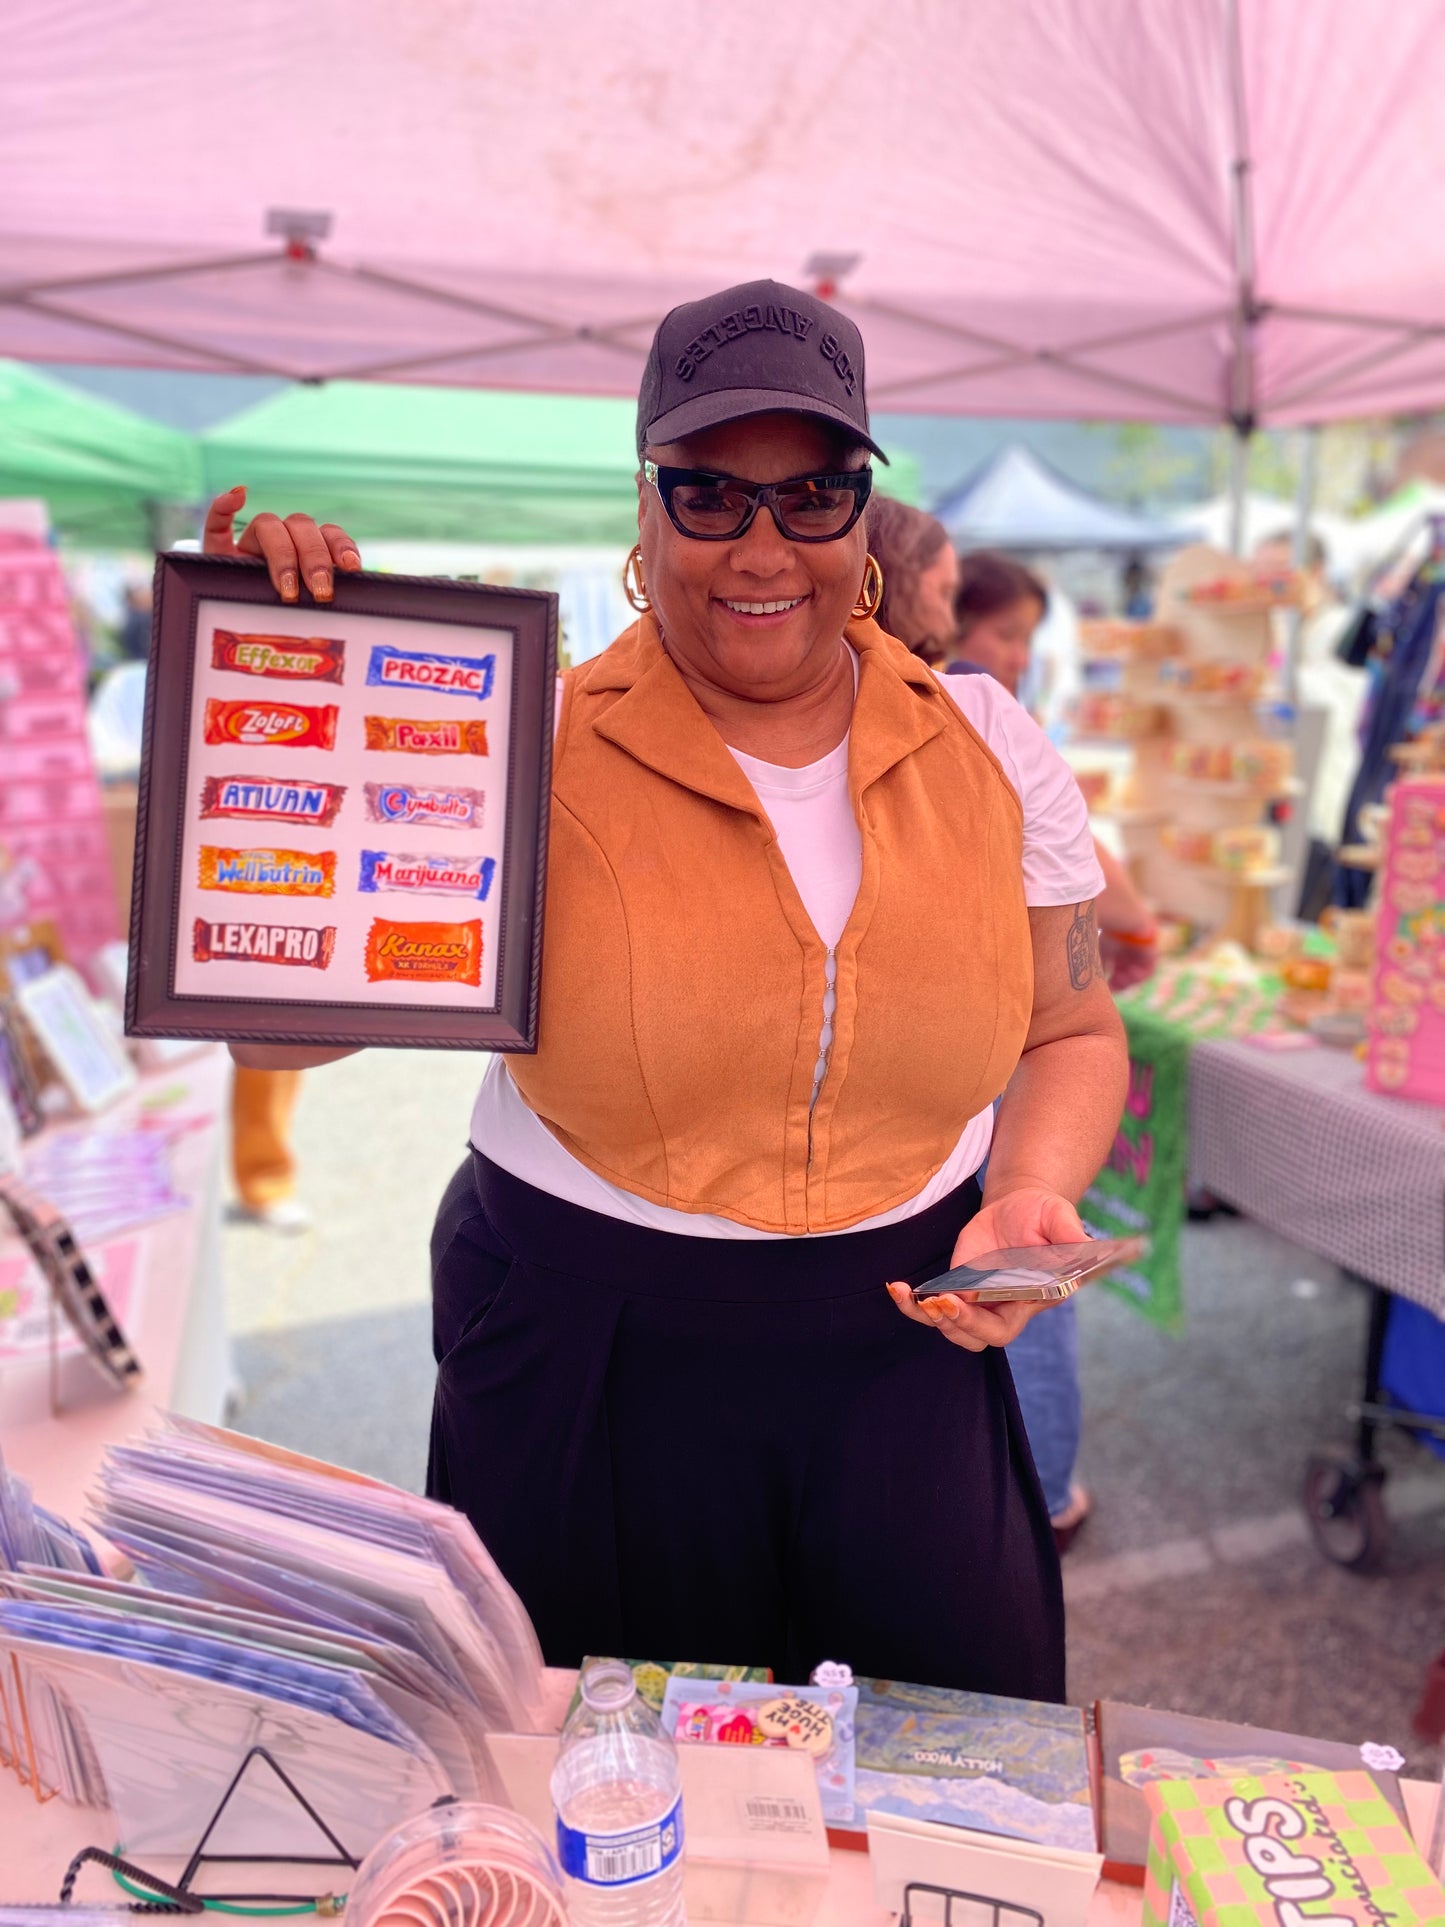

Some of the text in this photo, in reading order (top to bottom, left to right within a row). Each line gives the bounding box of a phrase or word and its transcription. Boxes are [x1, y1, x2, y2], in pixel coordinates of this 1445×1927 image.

[675, 304, 858, 397] LOS ANGELES
[234, 645, 321, 675] Effexor
[383, 661, 482, 691] PROZAC
[396, 725, 459, 750] Paxil
[221, 785, 323, 814] ATIVAN
[217, 860, 324, 885] Wellbutrin
[376, 863, 481, 887] Marijuana
[209, 925, 319, 960] LEXAPRO
[765, 1711, 790, 1727] MY
[777, 1702, 824, 1737] HUGE
[1223, 1796, 1358, 1927] TIPS
